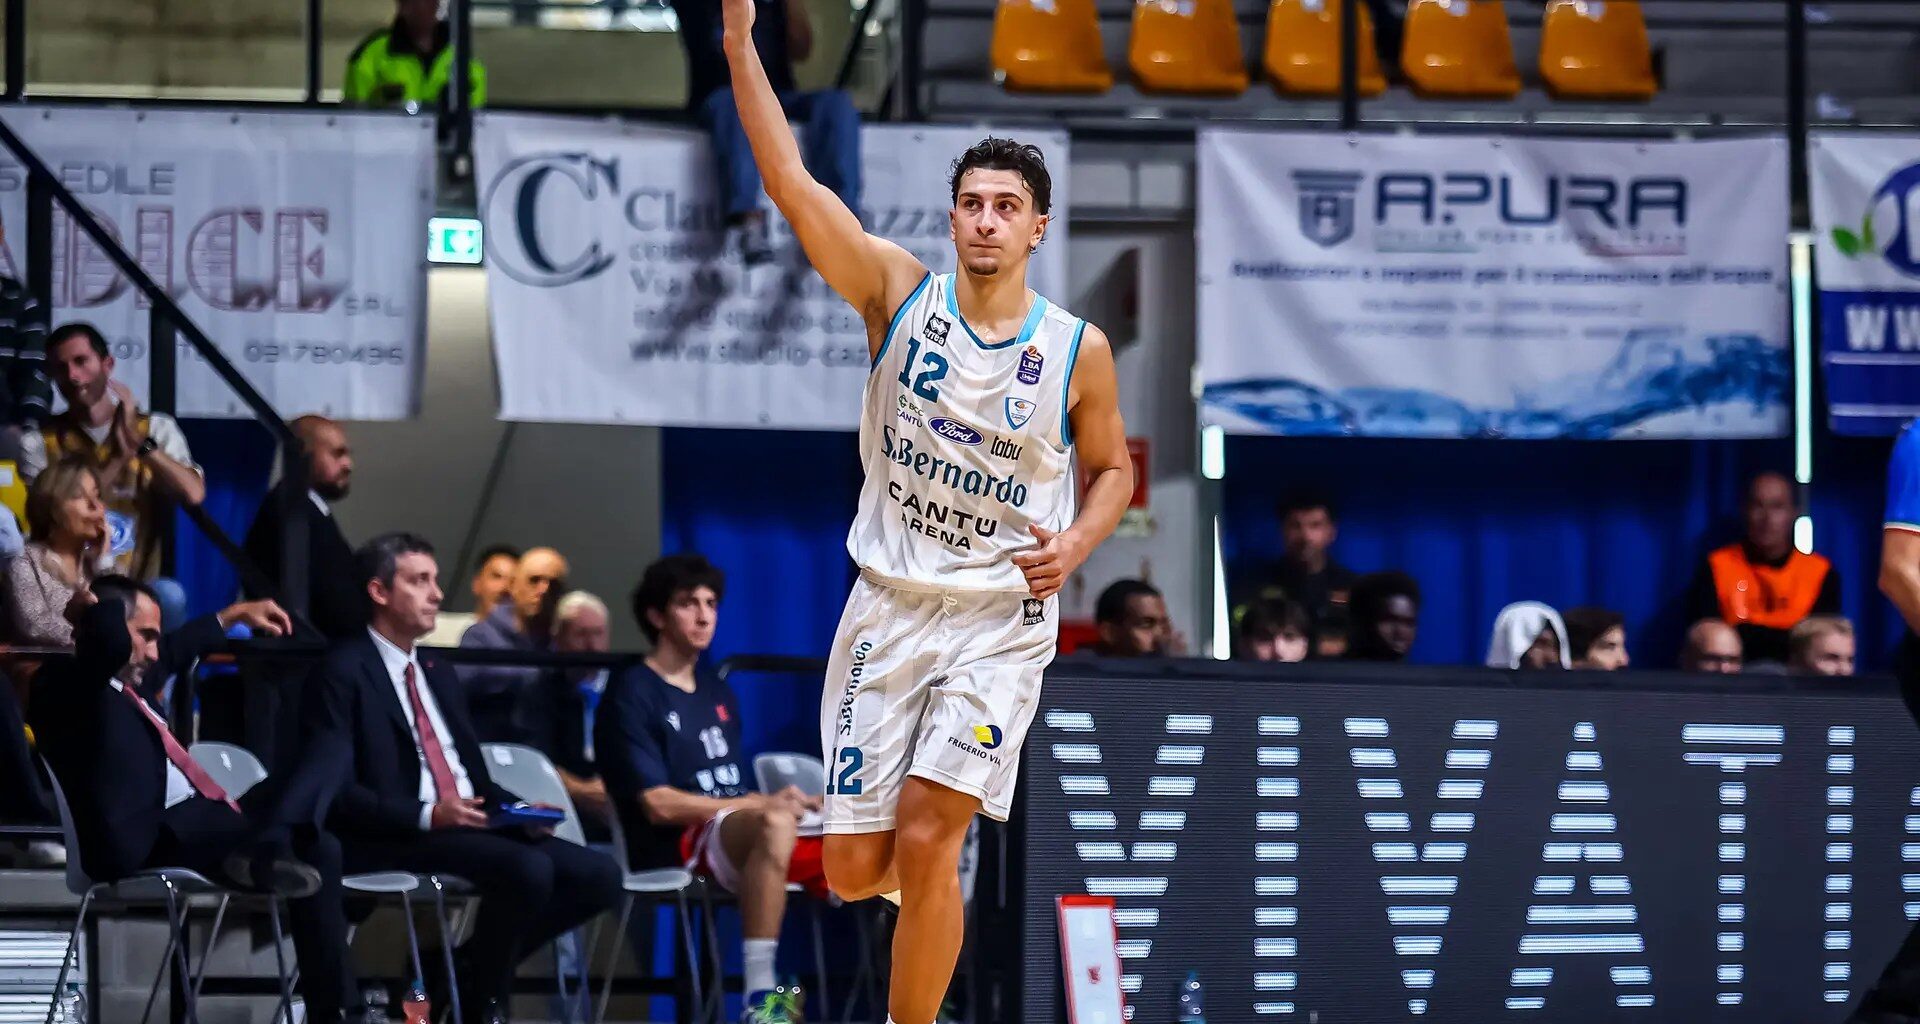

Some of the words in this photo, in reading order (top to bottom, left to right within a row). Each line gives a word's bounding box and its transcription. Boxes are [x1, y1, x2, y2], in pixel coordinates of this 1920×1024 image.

[0, 203, 346, 314] DICE
[898, 337, 949, 404] 12
[1021, 360, 1040, 371] LBA
[909, 402, 925, 417] BCC
[938, 420, 974, 443] Ford
[990, 435, 1023, 461] tabu
[902, 512, 972, 551] ARENA
[947, 736, 988, 759] FRIGERIO
[826, 746, 864, 795] 12
[1045, 708, 1920, 1018] VIVATI
